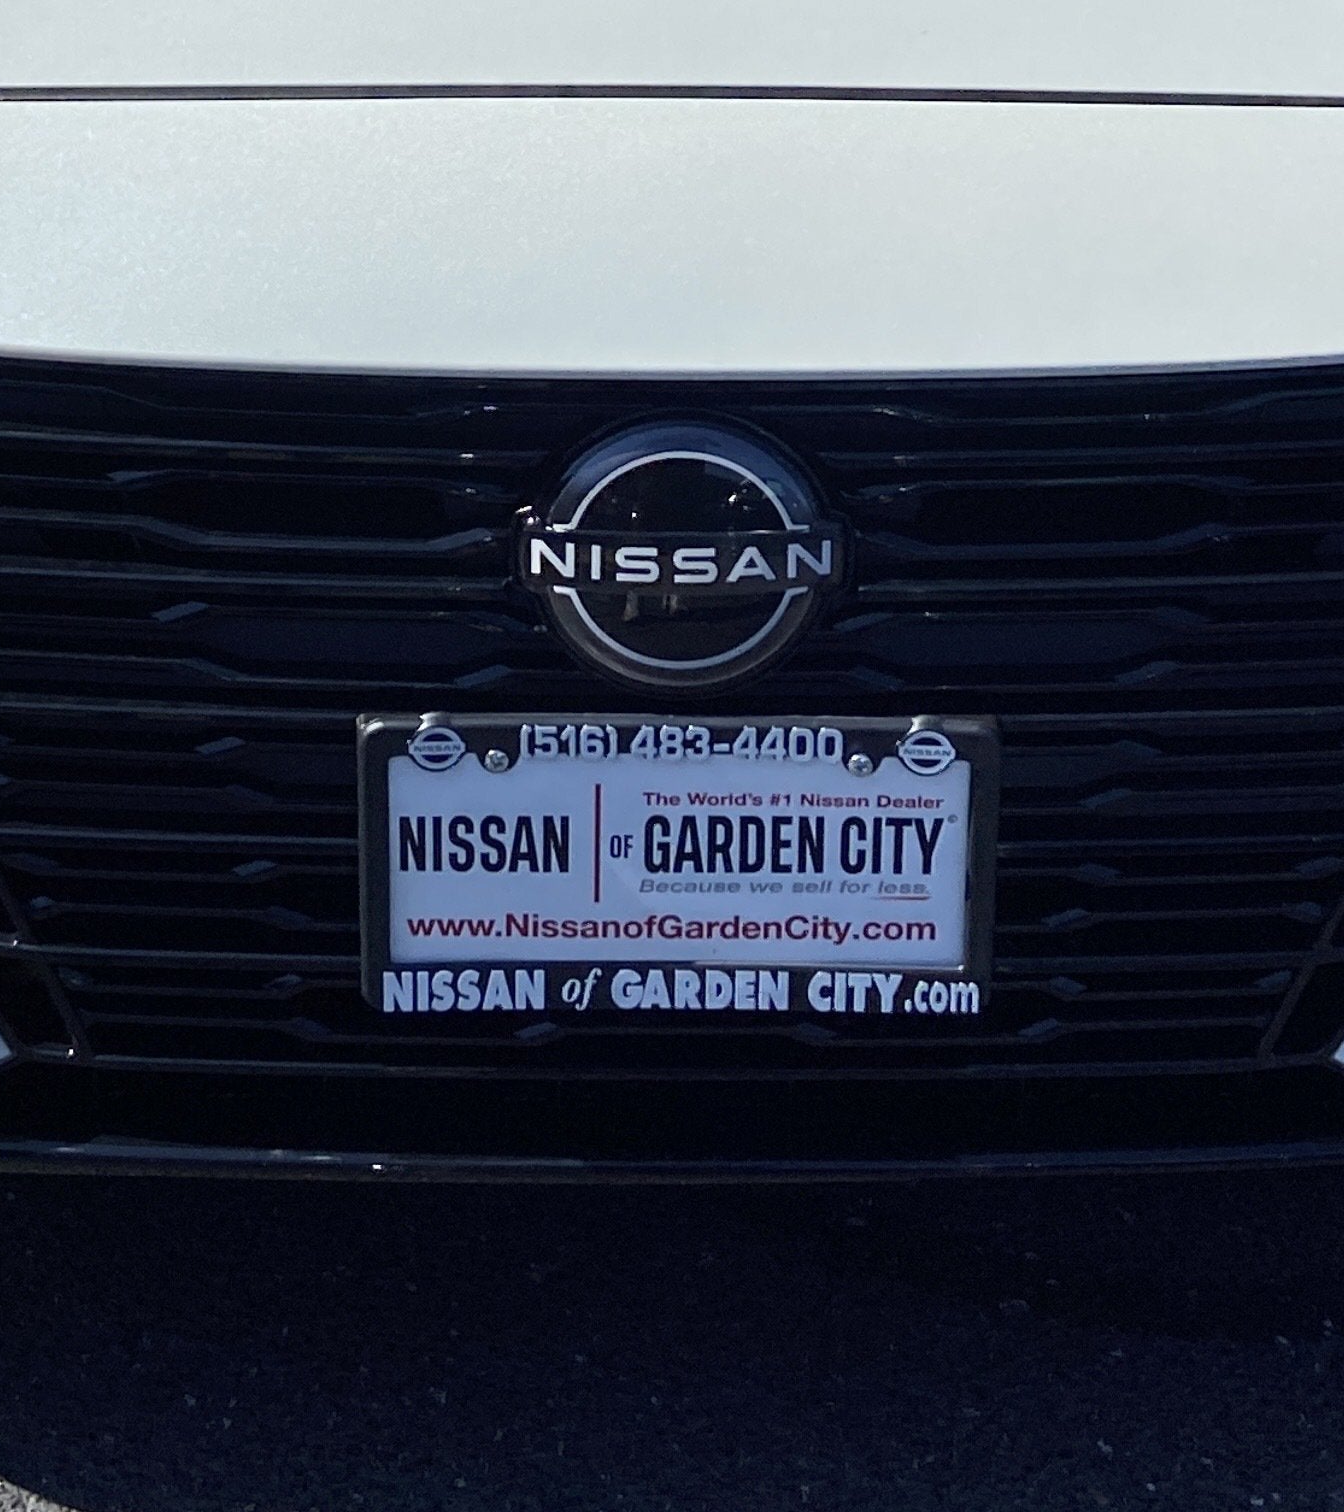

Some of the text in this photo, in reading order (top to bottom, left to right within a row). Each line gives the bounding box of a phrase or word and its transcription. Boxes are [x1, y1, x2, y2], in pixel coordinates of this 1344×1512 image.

[530, 538, 832, 584] NISSAN
[413, 743, 462, 753] NISSAN
[520, 724, 844, 764] (516) 483-4400
[902, 746, 952, 757] NISSAN
[643, 791, 945, 809] The World's #1 Nissan Dealer
[399, 815, 570, 873] NISSAN
[609, 814, 945, 875] OF GARDEN CITY
[639, 879, 741, 894] Because
[750, 881, 783, 894] we
[792, 880, 832, 895] sell
[840, 880, 871, 895] for
[407, 913, 937, 945] www.NissanofGardenCity.com
[382, 967, 980, 1014] NISSAN of GARDEN CITY.com
